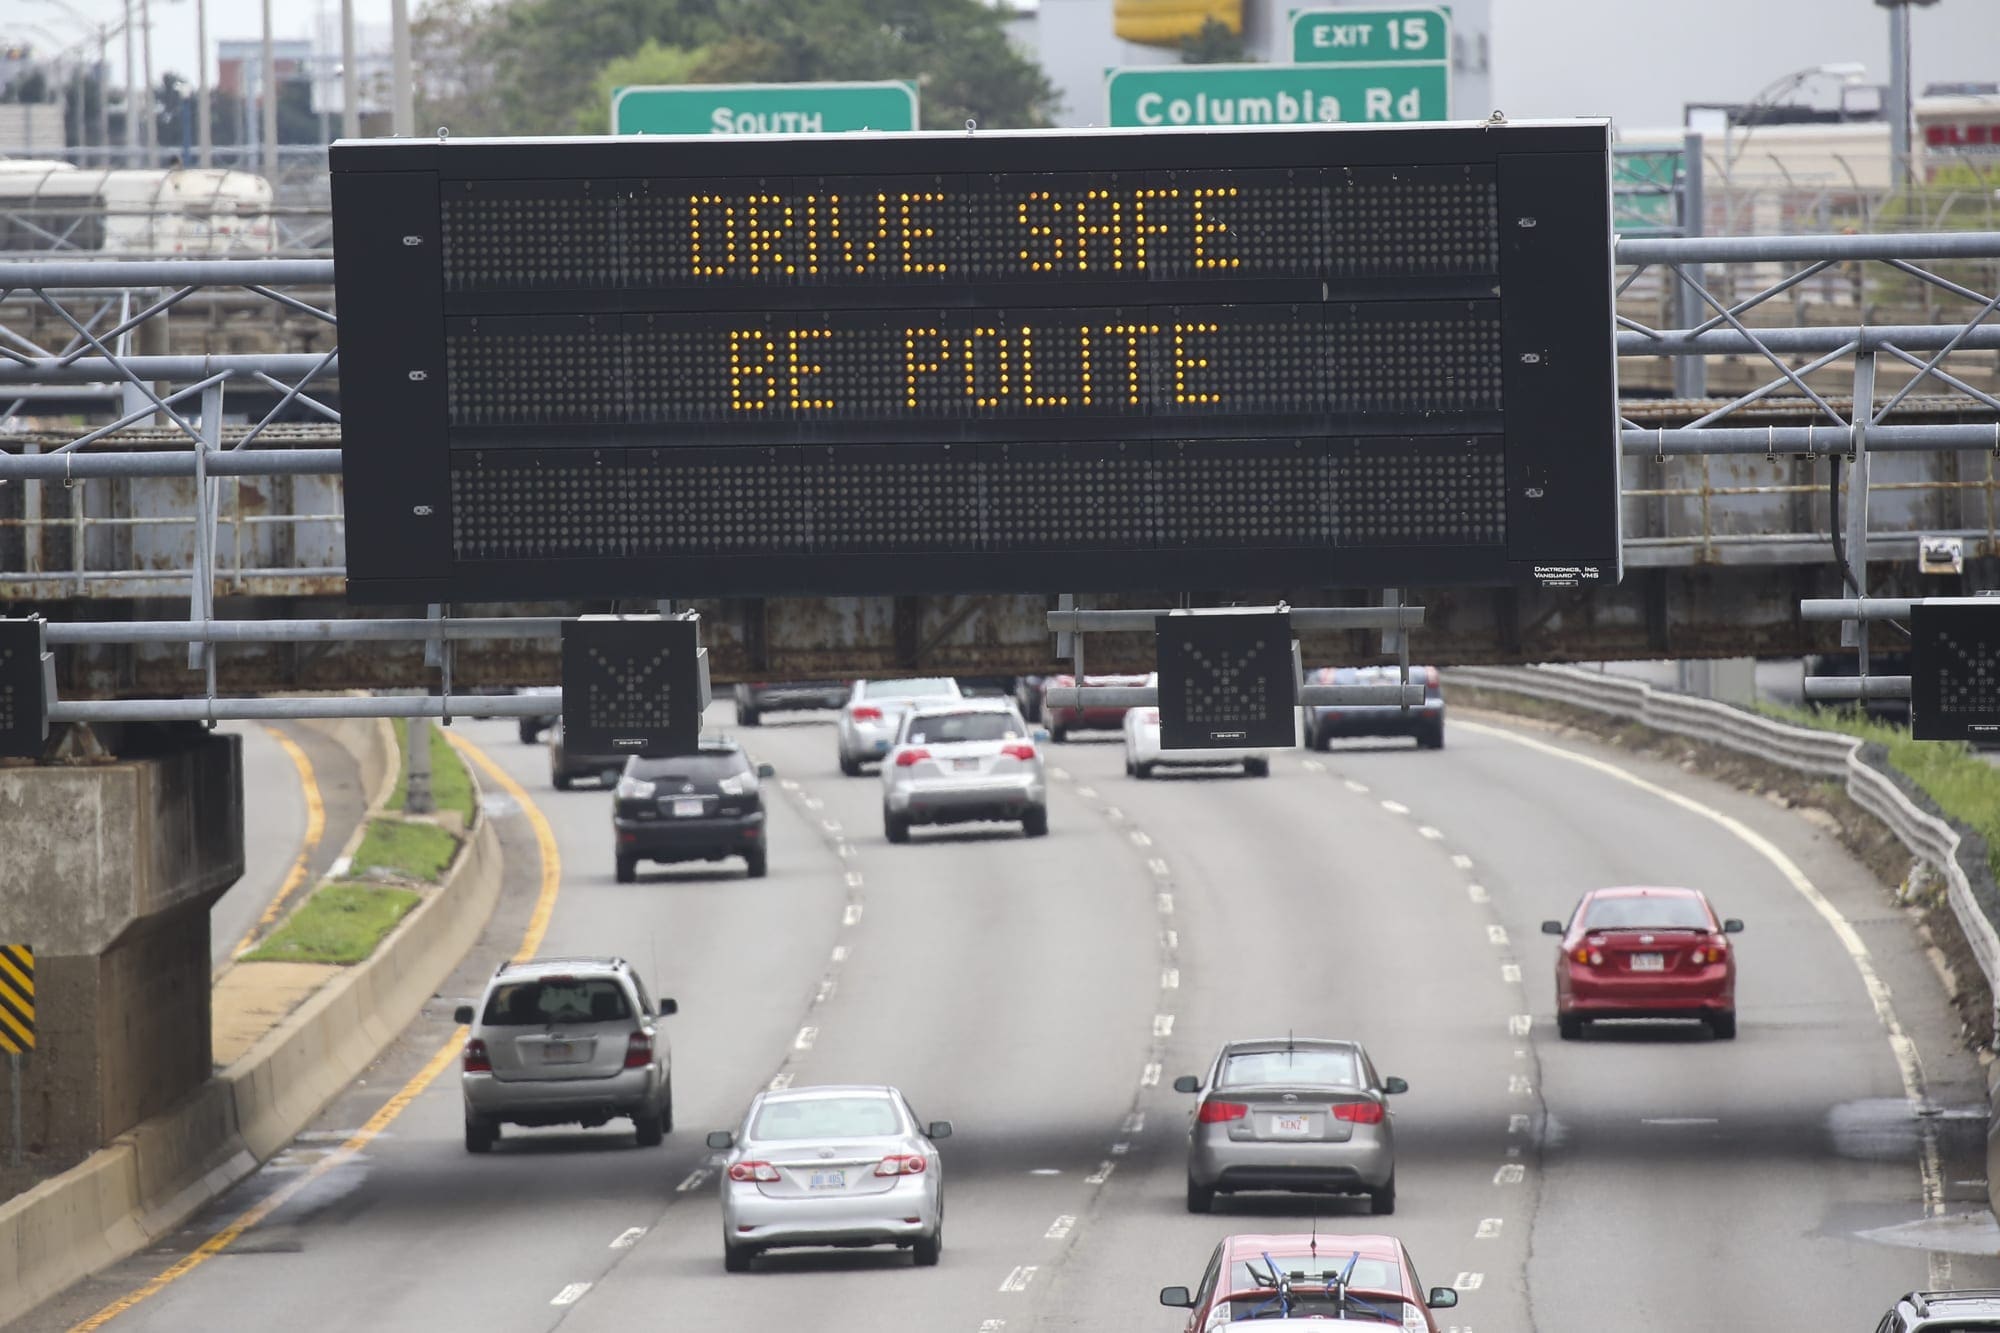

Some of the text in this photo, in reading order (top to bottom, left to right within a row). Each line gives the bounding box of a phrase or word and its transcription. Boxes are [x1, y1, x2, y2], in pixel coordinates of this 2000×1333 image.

[1312, 18, 1429, 50] EXIT 15
[710, 106, 823, 134] SOUTH
[1136, 88, 1421, 125] Columbia Rd
[690, 188, 1239, 275] DRIVE SAFE
[730, 323, 1221, 410] BE POLITE
